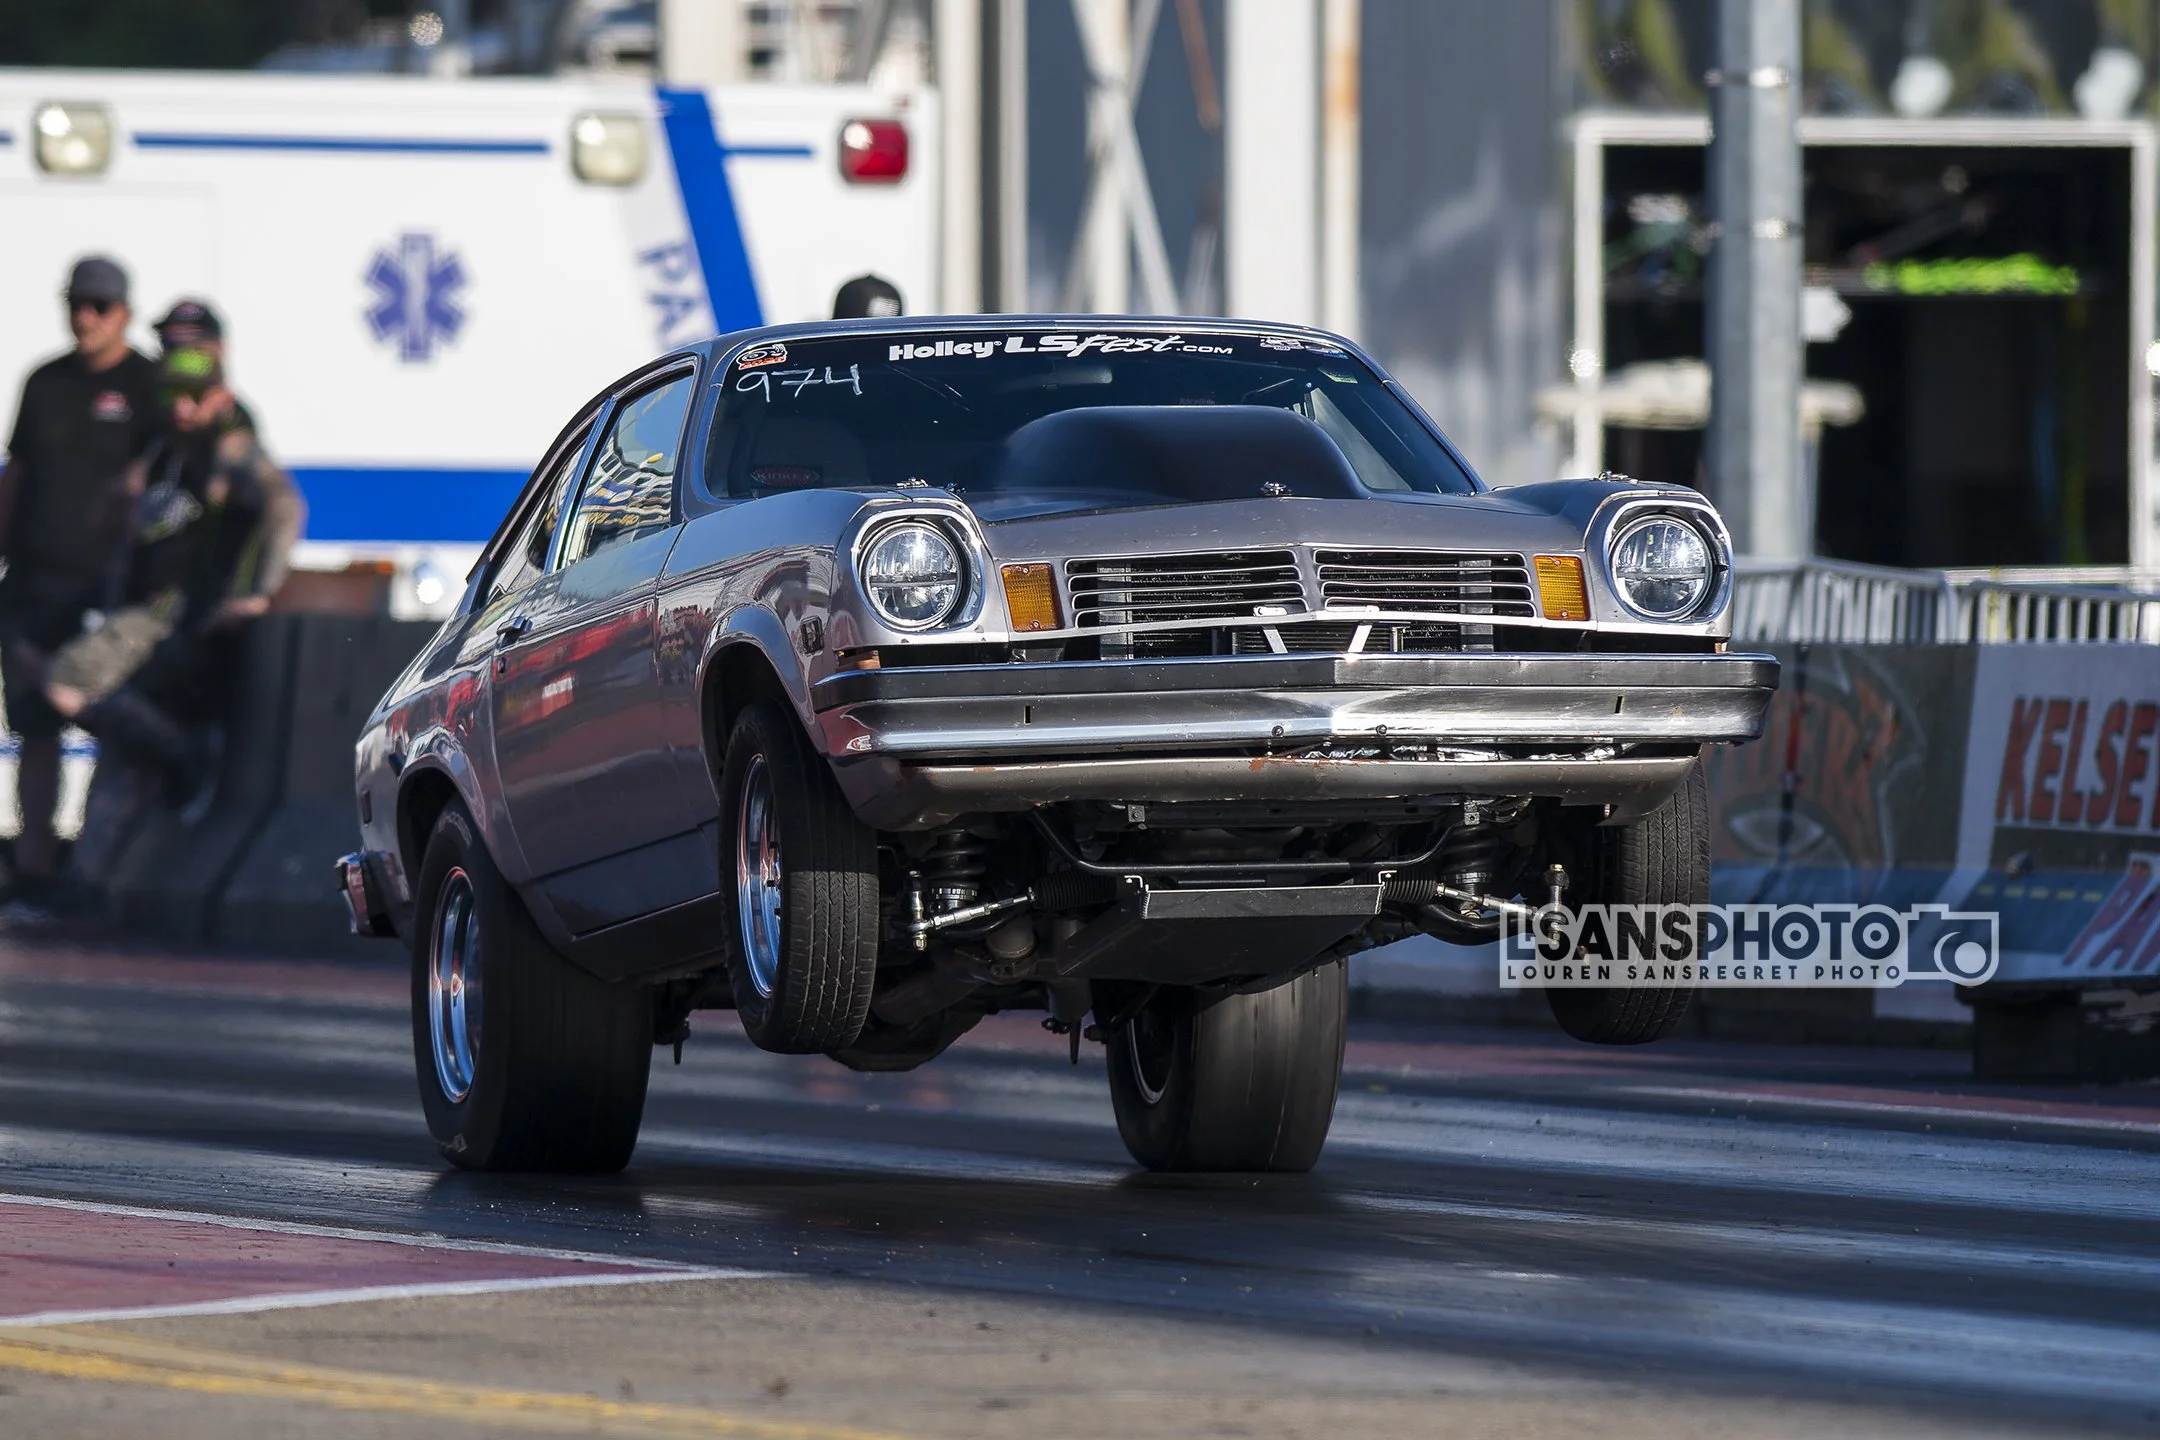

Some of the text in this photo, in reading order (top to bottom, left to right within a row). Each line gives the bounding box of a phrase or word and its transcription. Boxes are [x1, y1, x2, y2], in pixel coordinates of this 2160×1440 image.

[736, 363, 863, 403] 974
[1995, 696, 2160, 829] KELSE
[2062, 860, 2160, 972] PA
